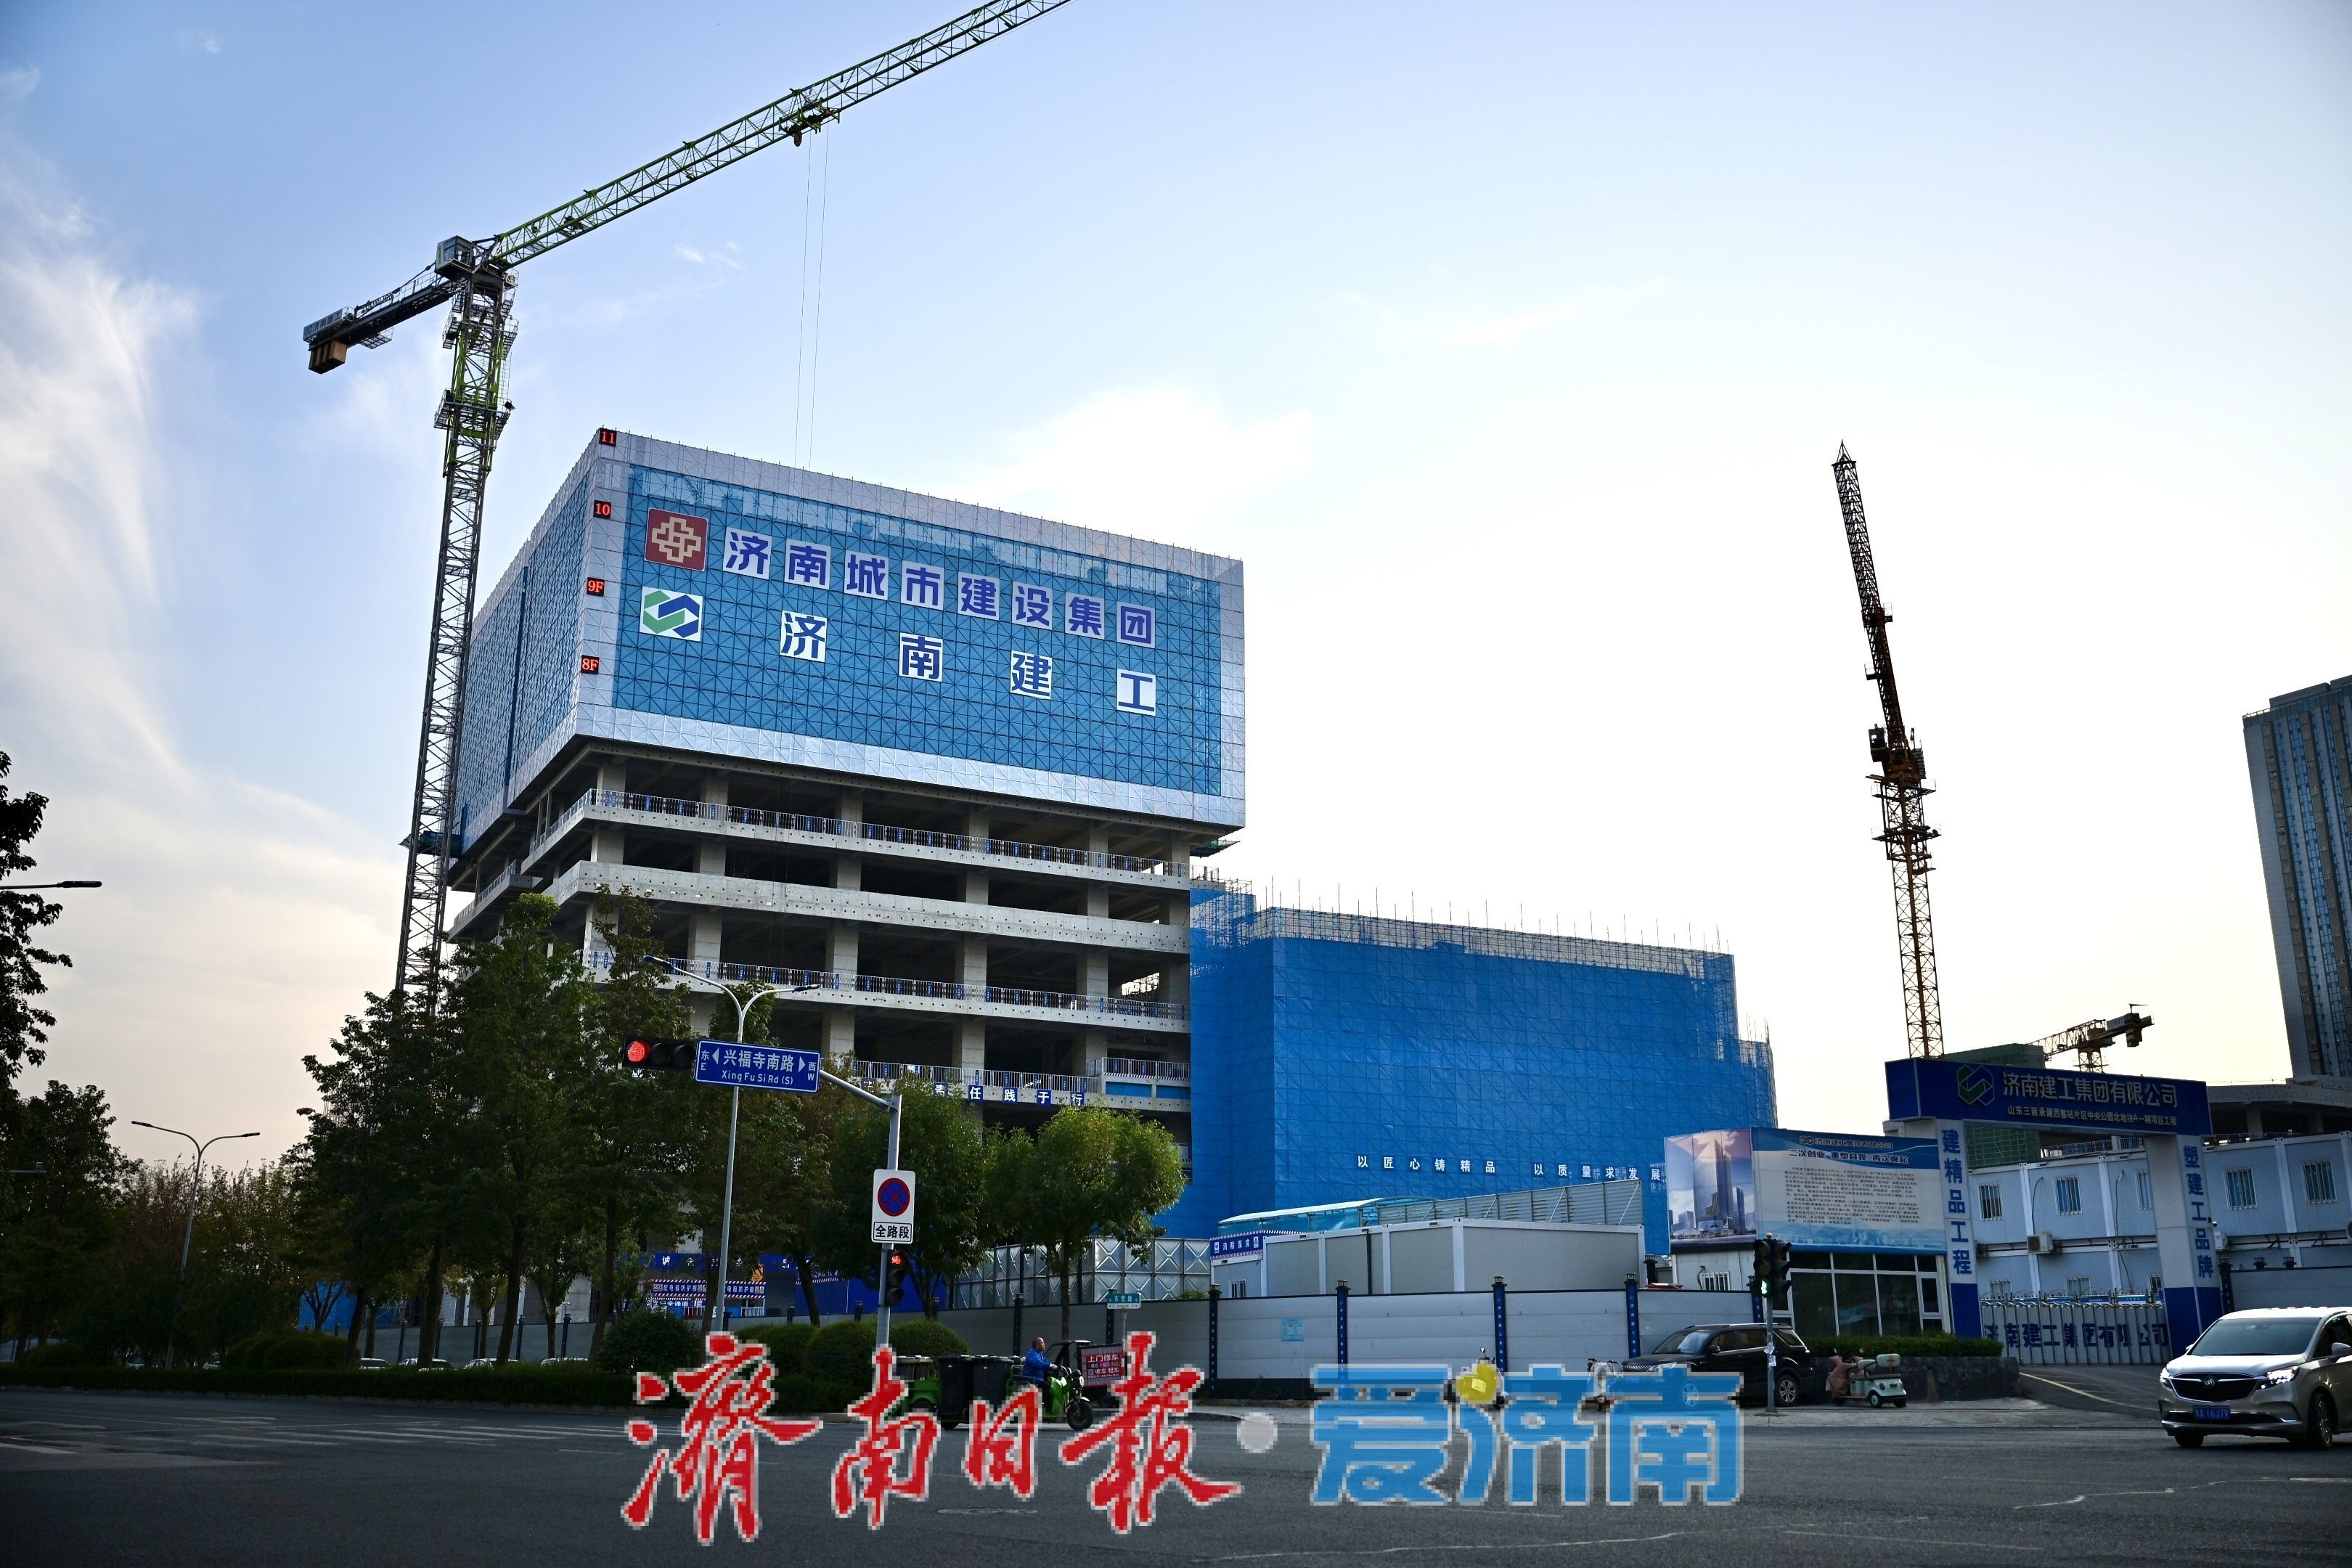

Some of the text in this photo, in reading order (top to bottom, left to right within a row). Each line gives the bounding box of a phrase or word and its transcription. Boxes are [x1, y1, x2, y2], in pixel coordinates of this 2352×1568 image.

[587, 579, 604, 592] 9F
[728, 529, 1154, 643] 济南城市建设集团
[581, 658, 599, 670] 8F
[782, 612, 1155, 713] 济南建工
[701, 1050, 710, 1061] 东
[722, 1049, 794, 1072] 兴福寺南路
[701, 1062, 706, 1071] E
[808, 1061, 816, 1071] 西
[934, 1083, 1085, 1106] 责任践于行
[2003, 1072, 2178, 1108] 济南建工集团有限公司
[1789, 1149, 1908, 1164] 二次创业 重塑自我 再次崛起
[1357, 1155, 1661, 1181] 以匠心铸精品 以质量求发展
[1941, 1129, 1972, 1275] 建精品工程
[2183, 1145, 2214, 1278] 塑建工品牌
[875, 1224, 910, 1239] 全路段
[1222, 1238, 1250, 1251] 消防泵房
[1087, 1353, 1119, 1363] 上门修车
